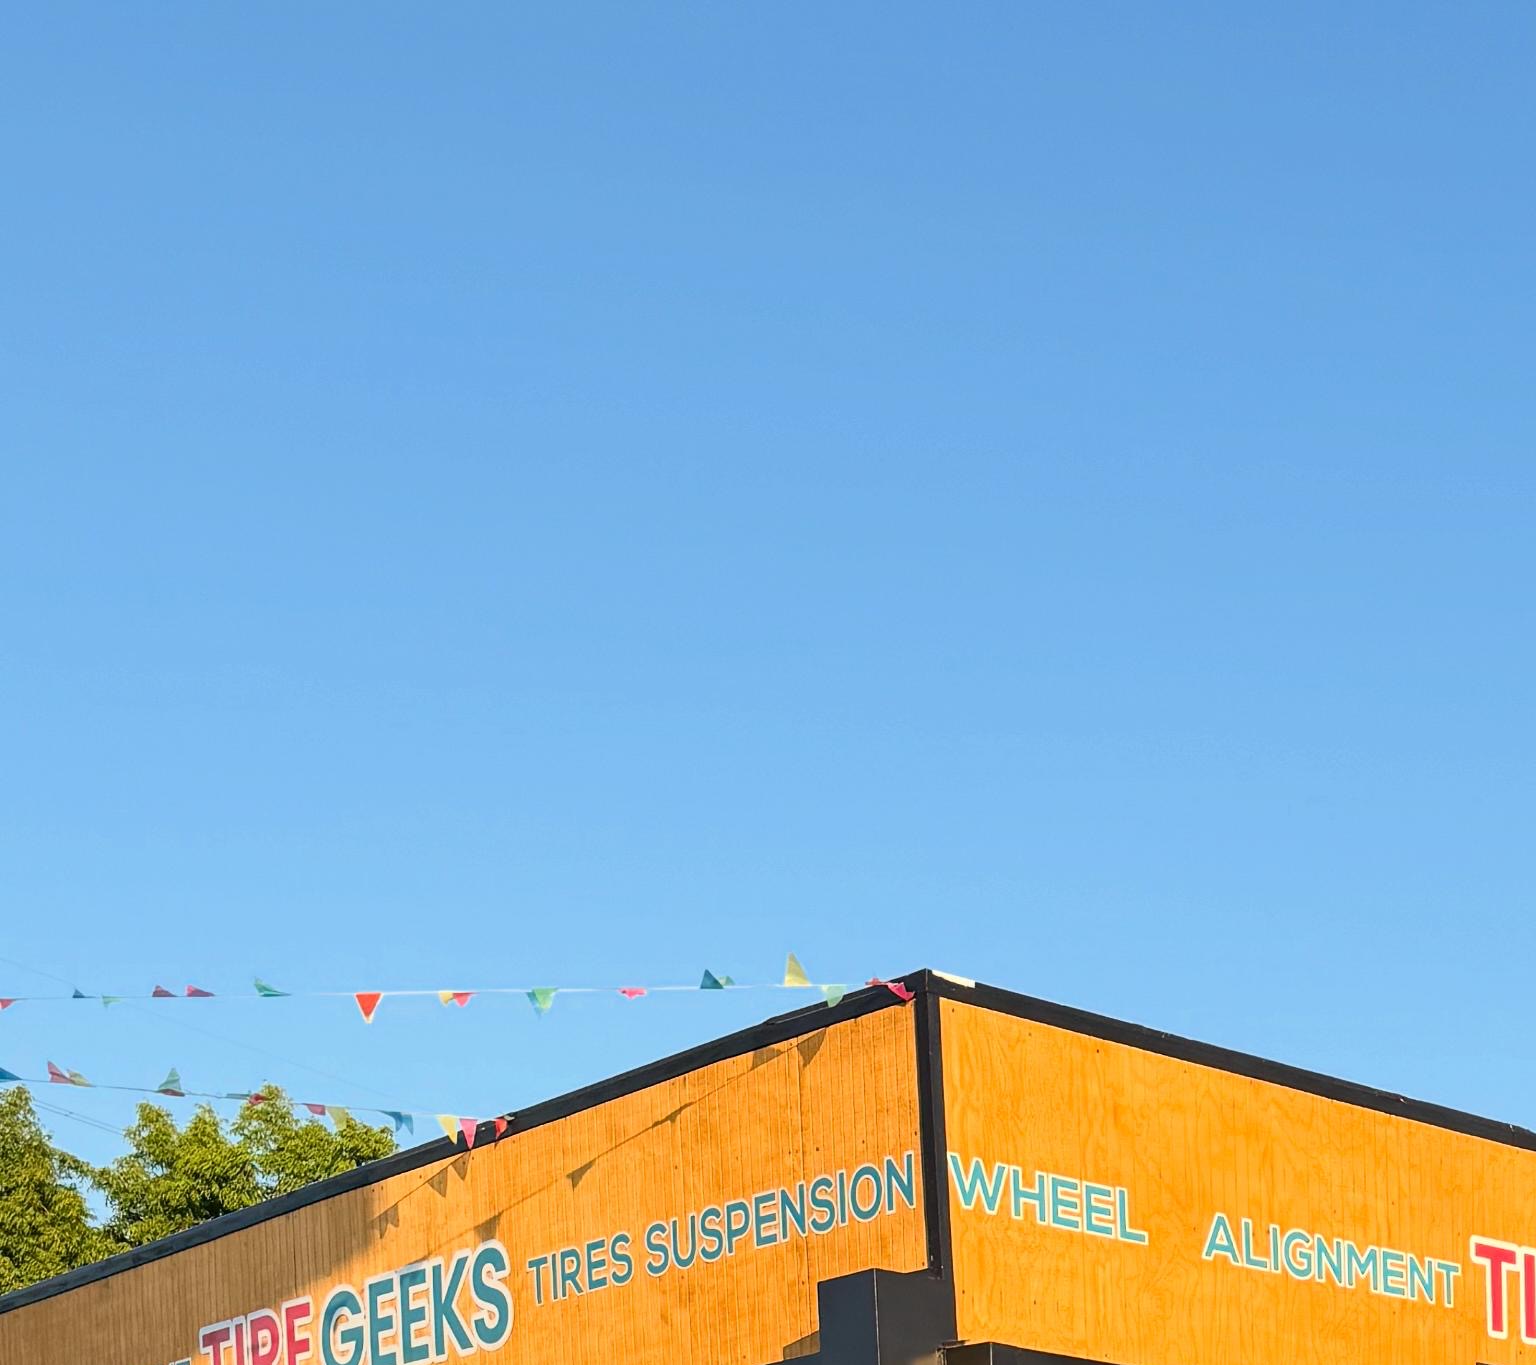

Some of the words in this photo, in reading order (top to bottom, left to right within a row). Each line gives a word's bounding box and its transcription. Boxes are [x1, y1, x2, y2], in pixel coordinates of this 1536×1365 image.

[527, 1231, 633, 1306] TIRES
[645, 1150, 917, 1277] SUSPENSION
[947, 1150, 1149, 1245] WHEEL
[1202, 1212, 1461, 1308] ALIGNMENT
